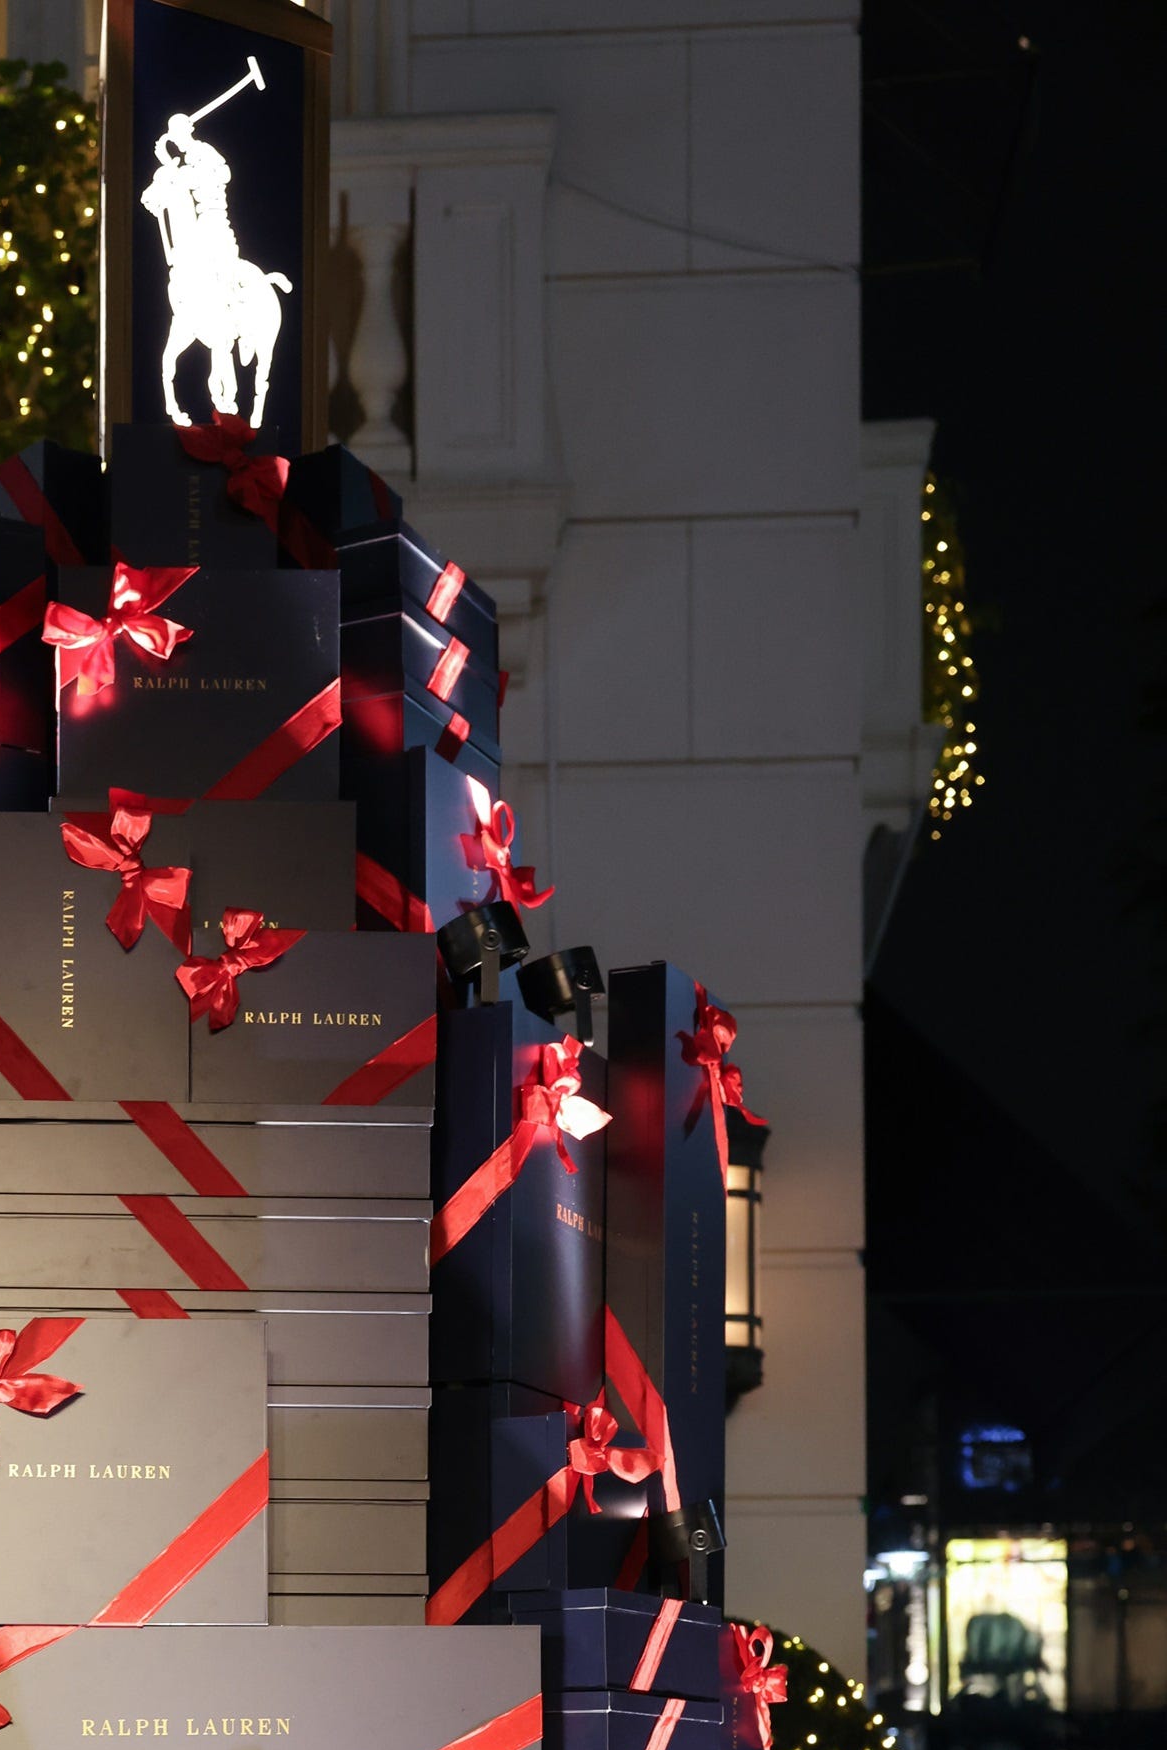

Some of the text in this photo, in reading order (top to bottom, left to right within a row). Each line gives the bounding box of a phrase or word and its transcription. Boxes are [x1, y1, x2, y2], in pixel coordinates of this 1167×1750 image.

[133, 676, 267, 690] RALPH LAUREN
[61, 889, 75, 1028] RALPH LAUREN
[244, 1011, 382, 1026] RALPH LAUREN
[555, 1203, 584, 1232] RALPH
[8, 1464, 171, 1479] RALPH LAUREN
[81, 1718, 290, 1736] RALPH LAUREN
